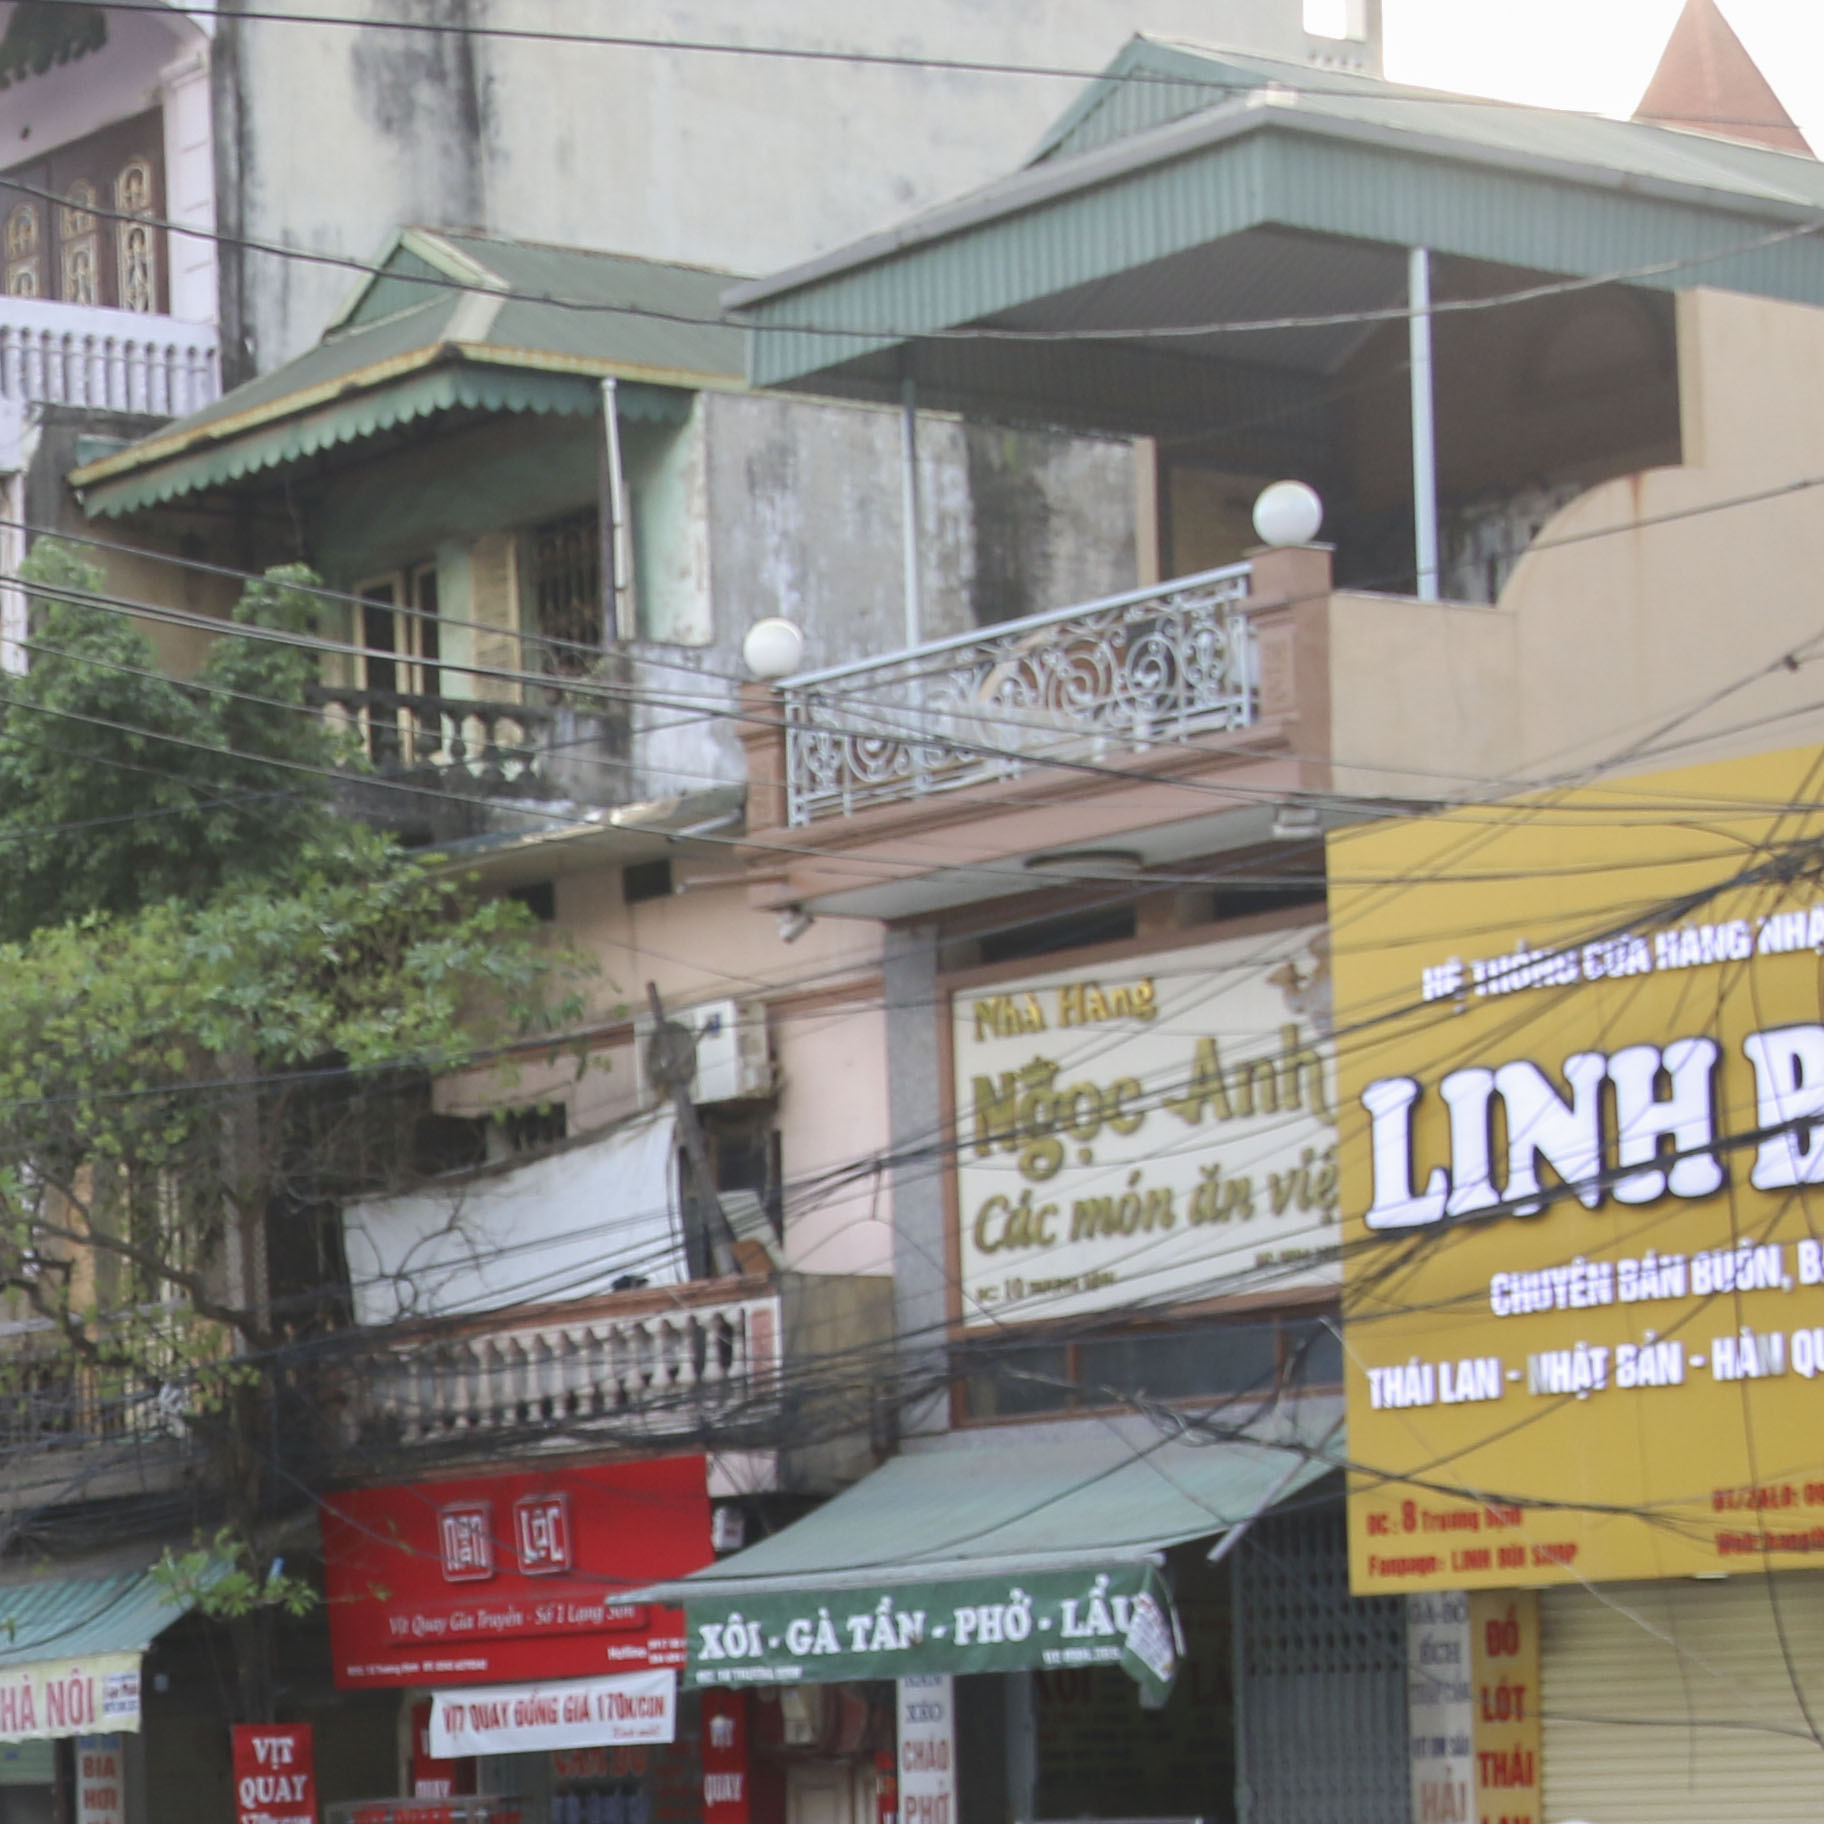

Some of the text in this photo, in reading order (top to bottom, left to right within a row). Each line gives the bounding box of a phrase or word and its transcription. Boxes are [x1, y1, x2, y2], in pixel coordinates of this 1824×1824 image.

[1583, 933, 1650, 981] CỦA
[1656, 920, 1750, 970] HÀNG
[973, 976, 1158, 1042] Nhà Hàng
[971, 1024, 1340, 1182] Ngọc Anh
[1362, 1024, 1824, 1230] LINH B
[974, 1146, 1341, 1254] Các món ăn việ
[1490, 1238, 1824, 1317] CHUYÊN BÁN BUÔN, B
[1368, 1356, 1434, 1409] THÁI
[1439, 1357, 1501, 1403] LAN
[1528, 1342, 1608, 1400] NHẬT
[1616, 1330, 1684, 1388] BẢN
[1713, 1327, 1786, 1381] HÀN
[1792, 1330, 1824, 1378] QU
[1402, 1500, 1416, 1533] 8
[389, 1616, 409, 1635] Vịt
[412, 1613, 447, 1637] Quay
[450, 1612, 474, 1630] Gia
[478, 1606, 523, 1632] Truyền
[698, 1613, 763, 1660] XÔI
[786, 1609, 840, 1655] GÀ
[954, 1588, 1033, 1646] PHỞ
[0, 1674, 37, 1732] HÀ
[46, 1668, 96, 1733] NỘI
[469, 1701, 508, 1732] QUAY
[83, 1755, 116, 1778] BIA
[252, 1736, 293, 1770] VỊT
[1478, 1743, 1534, 1788] THÁI
[240, 1775, 307, 1809] QUAY
[704, 1774, 742, 1806] QUAY
